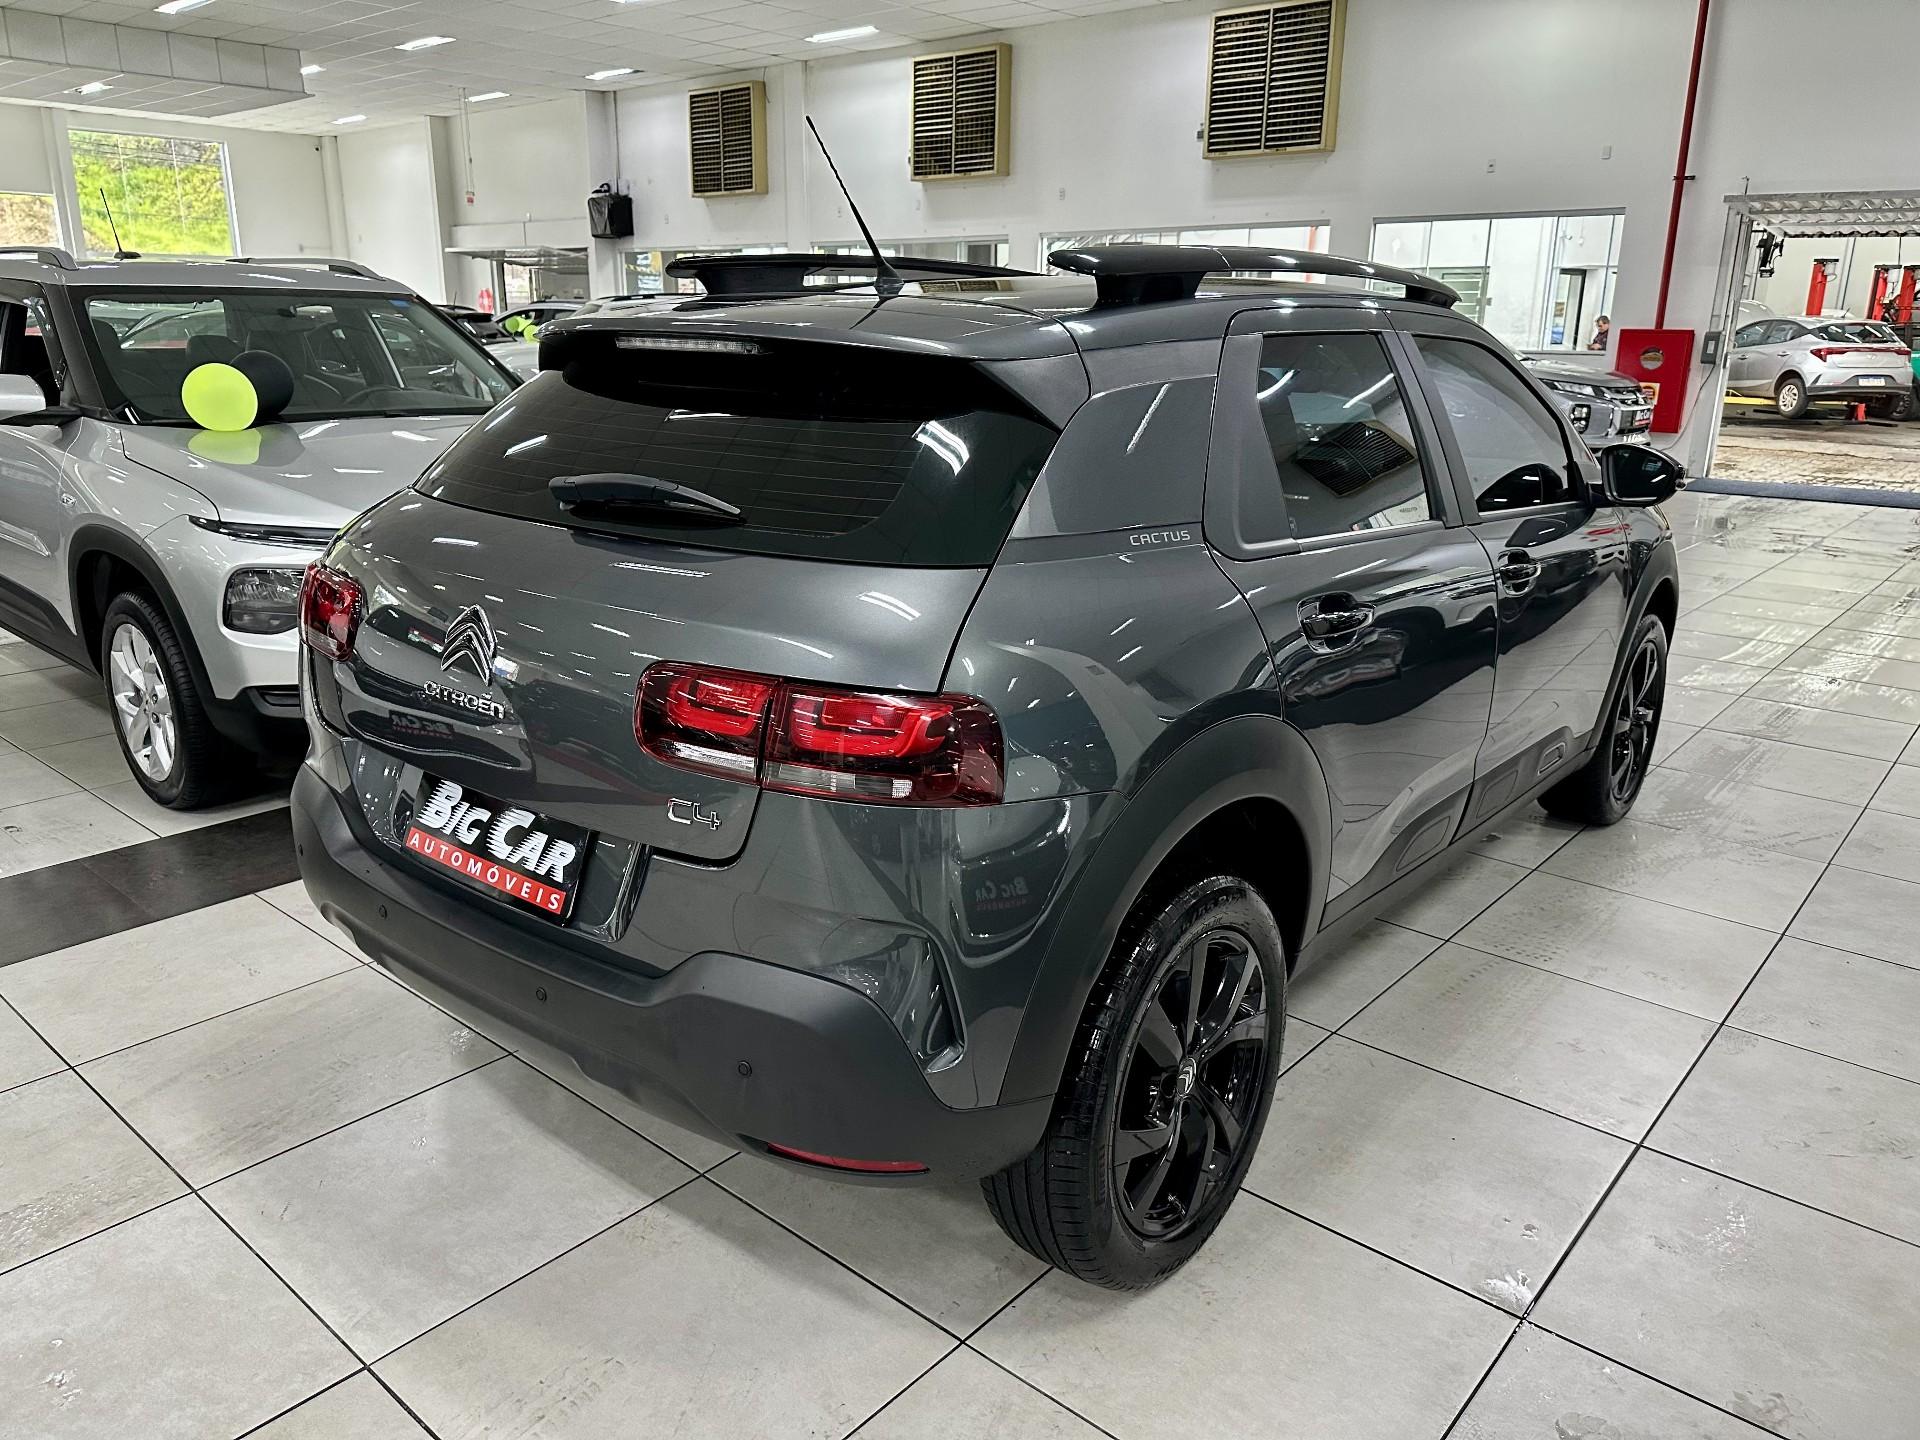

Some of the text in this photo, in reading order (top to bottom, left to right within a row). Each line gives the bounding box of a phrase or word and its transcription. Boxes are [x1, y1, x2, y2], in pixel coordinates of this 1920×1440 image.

[1129, 530, 1191, 546] CACTUS
[423, 680, 506, 719] CITROËN
[667, 797, 721, 831] C4
[409, 831, 561, 910] AUTOMÓVEIS
